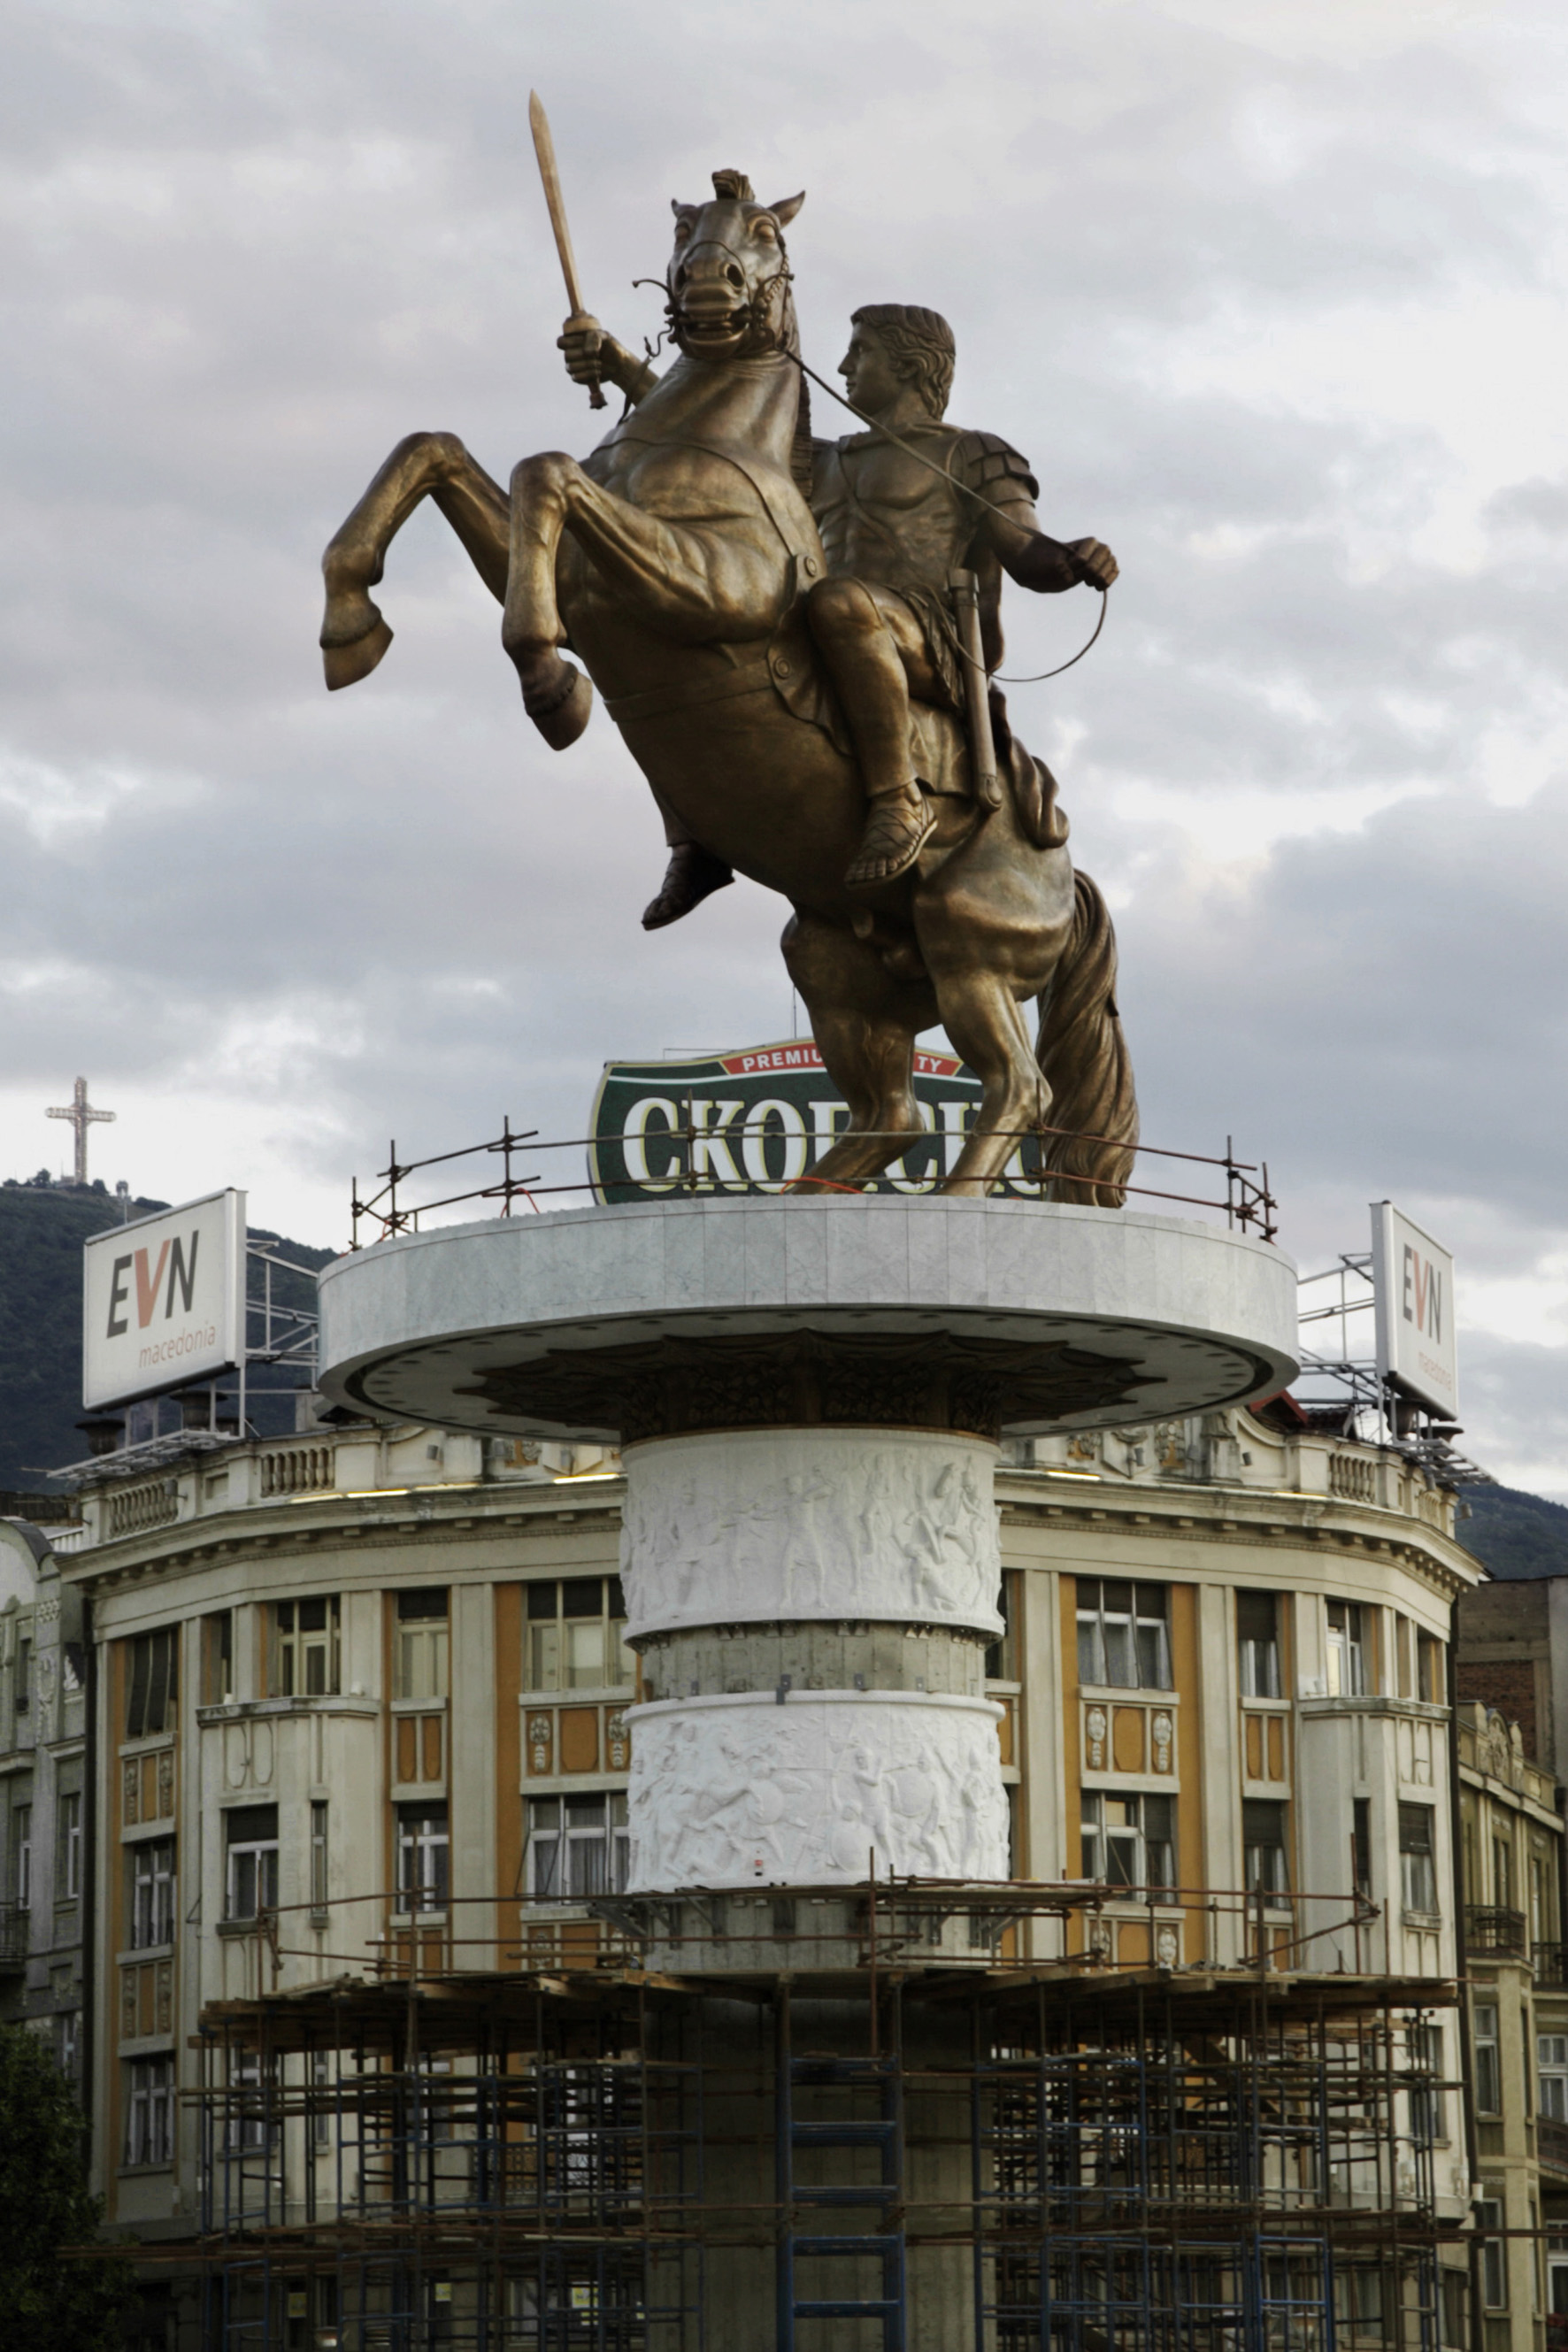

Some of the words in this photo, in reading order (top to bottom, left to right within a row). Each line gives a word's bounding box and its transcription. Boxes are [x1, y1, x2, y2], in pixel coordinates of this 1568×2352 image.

[742, 1049, 824, 1072] PREMIU
[107, 1230, 199, 1339] EVN
[1403, 1244, 1441, 1344] EVN
[139, 1320, 216, 1368] macedonia
